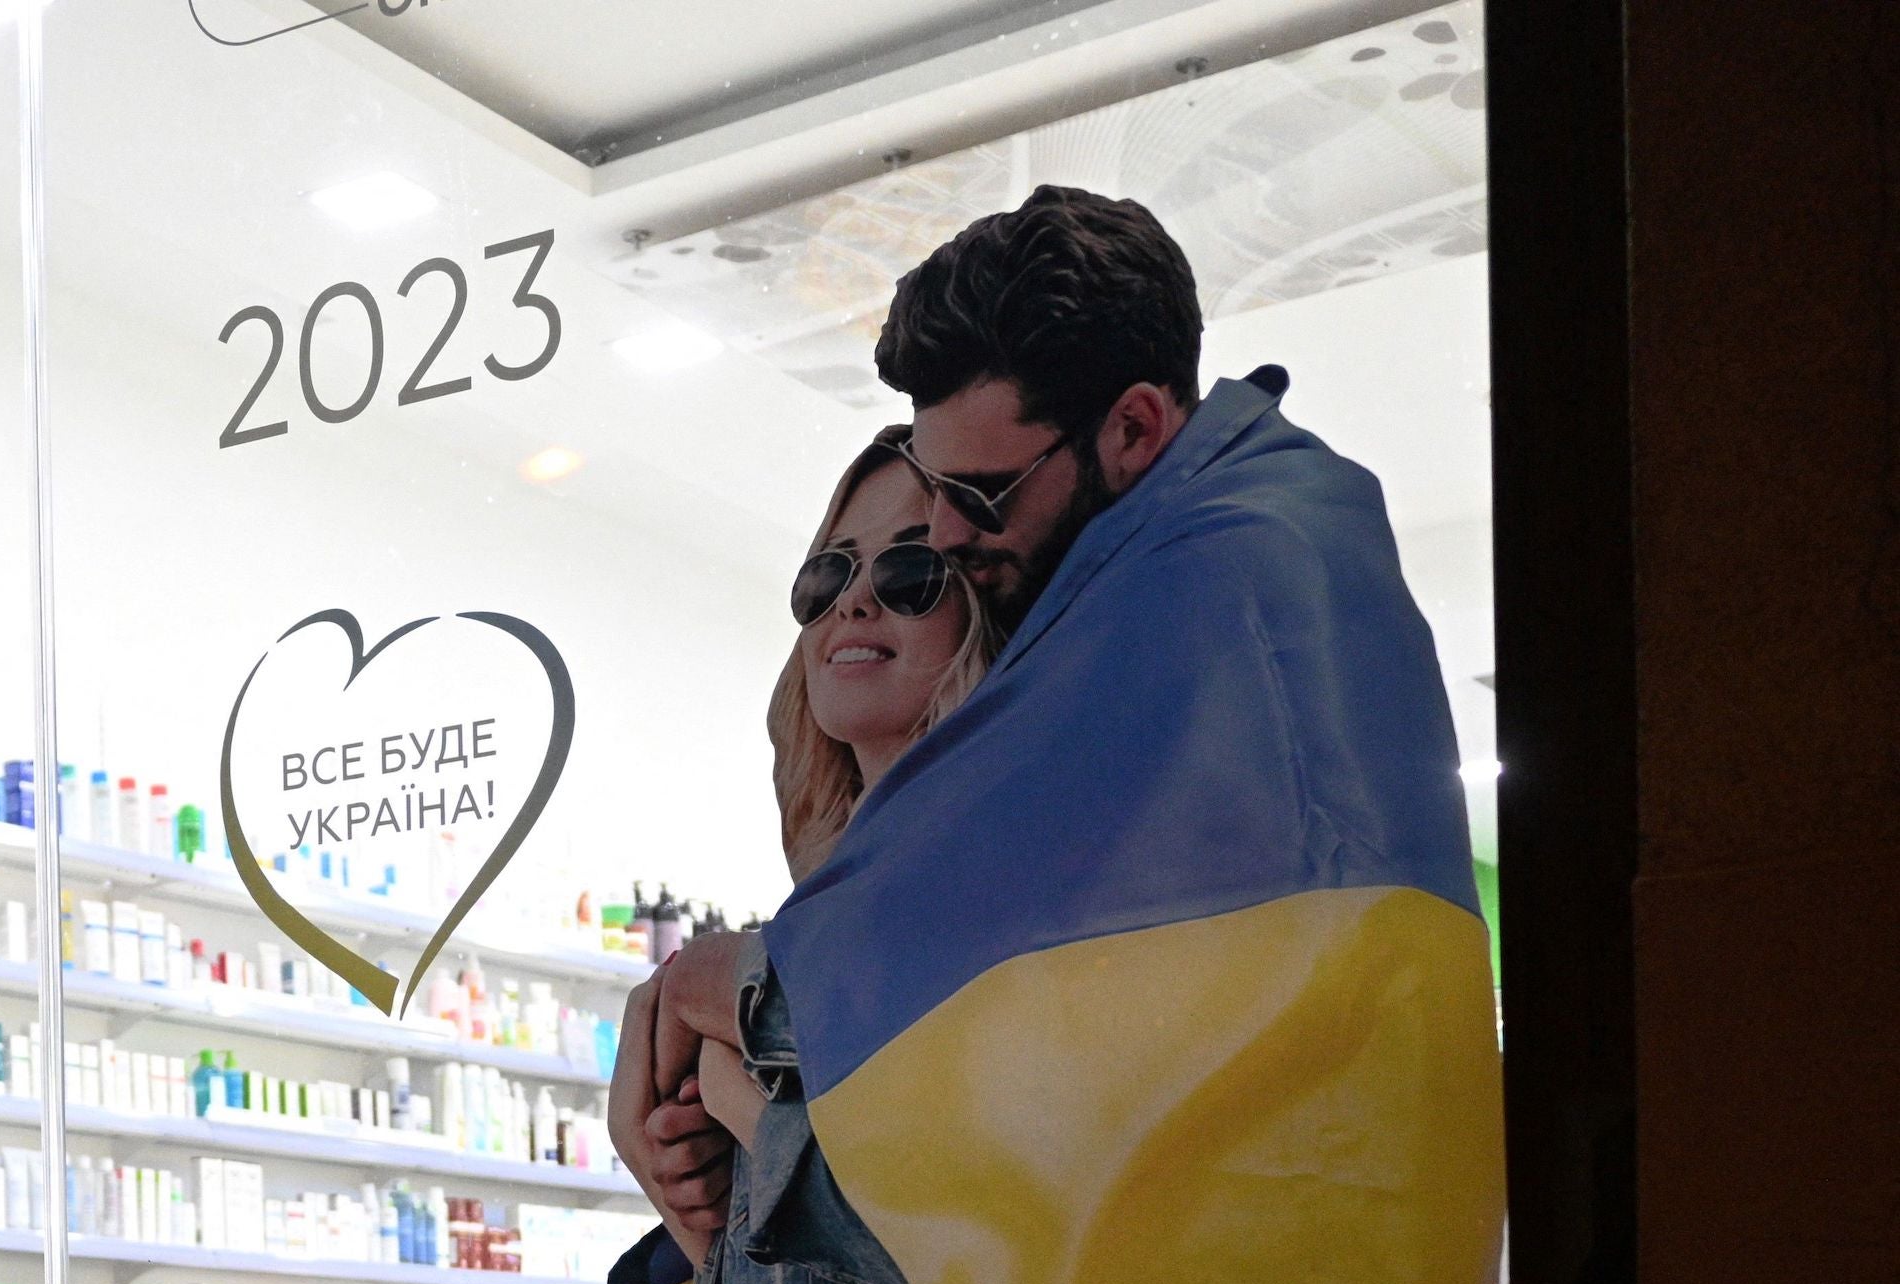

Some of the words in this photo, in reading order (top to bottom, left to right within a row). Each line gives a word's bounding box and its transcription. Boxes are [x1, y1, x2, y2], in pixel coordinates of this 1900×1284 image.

[217, 228, 562, 450] 2023
[281, 741, 366, 791] ВСЕ
[379, 717, 498, 775] БУДЕ
[286, 779, 497, 851] УКРАЇНА!
